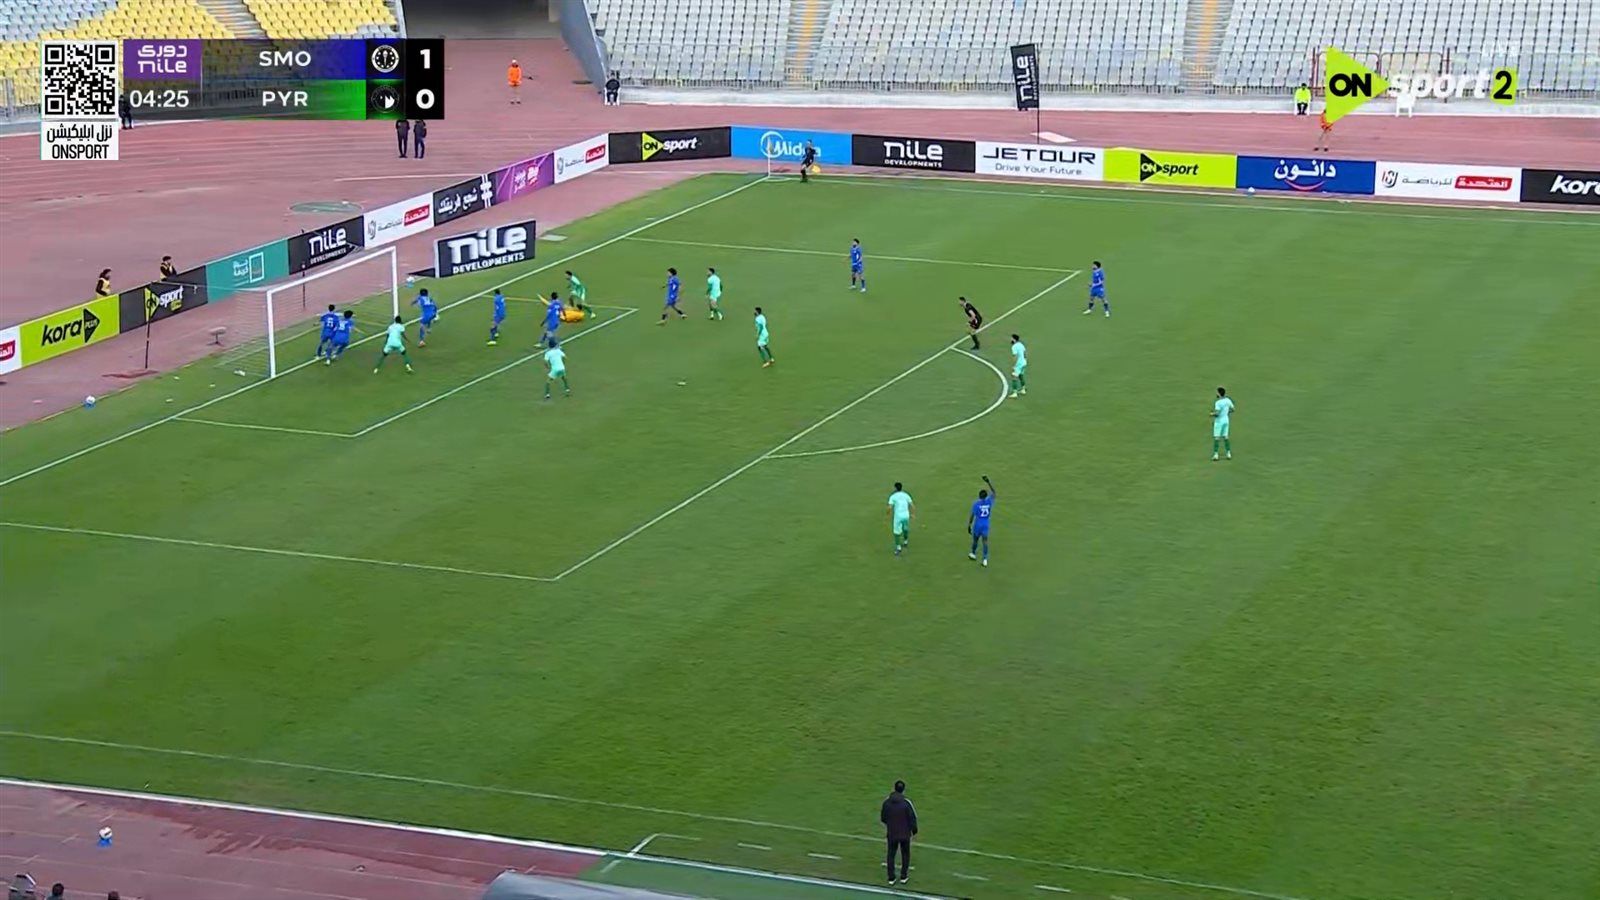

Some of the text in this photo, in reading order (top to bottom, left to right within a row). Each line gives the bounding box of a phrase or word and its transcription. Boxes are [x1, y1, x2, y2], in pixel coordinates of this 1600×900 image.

[644, 137, 698, 154] ON sport
[884, 159, 942, 168] DEVELOPMENTS
[983, 147, 1096, 165] JETOUR
[995, 163, 1082, 175] Drive Your Future
[1141, 163, 1199, 176] ON sport
[1274, 160, 1337, 180] دانون
[452, 251, 525, 274] DEVELOPMENTS
[160, 284, 184, 308] sport
[41, 319, 82, 346] kora
